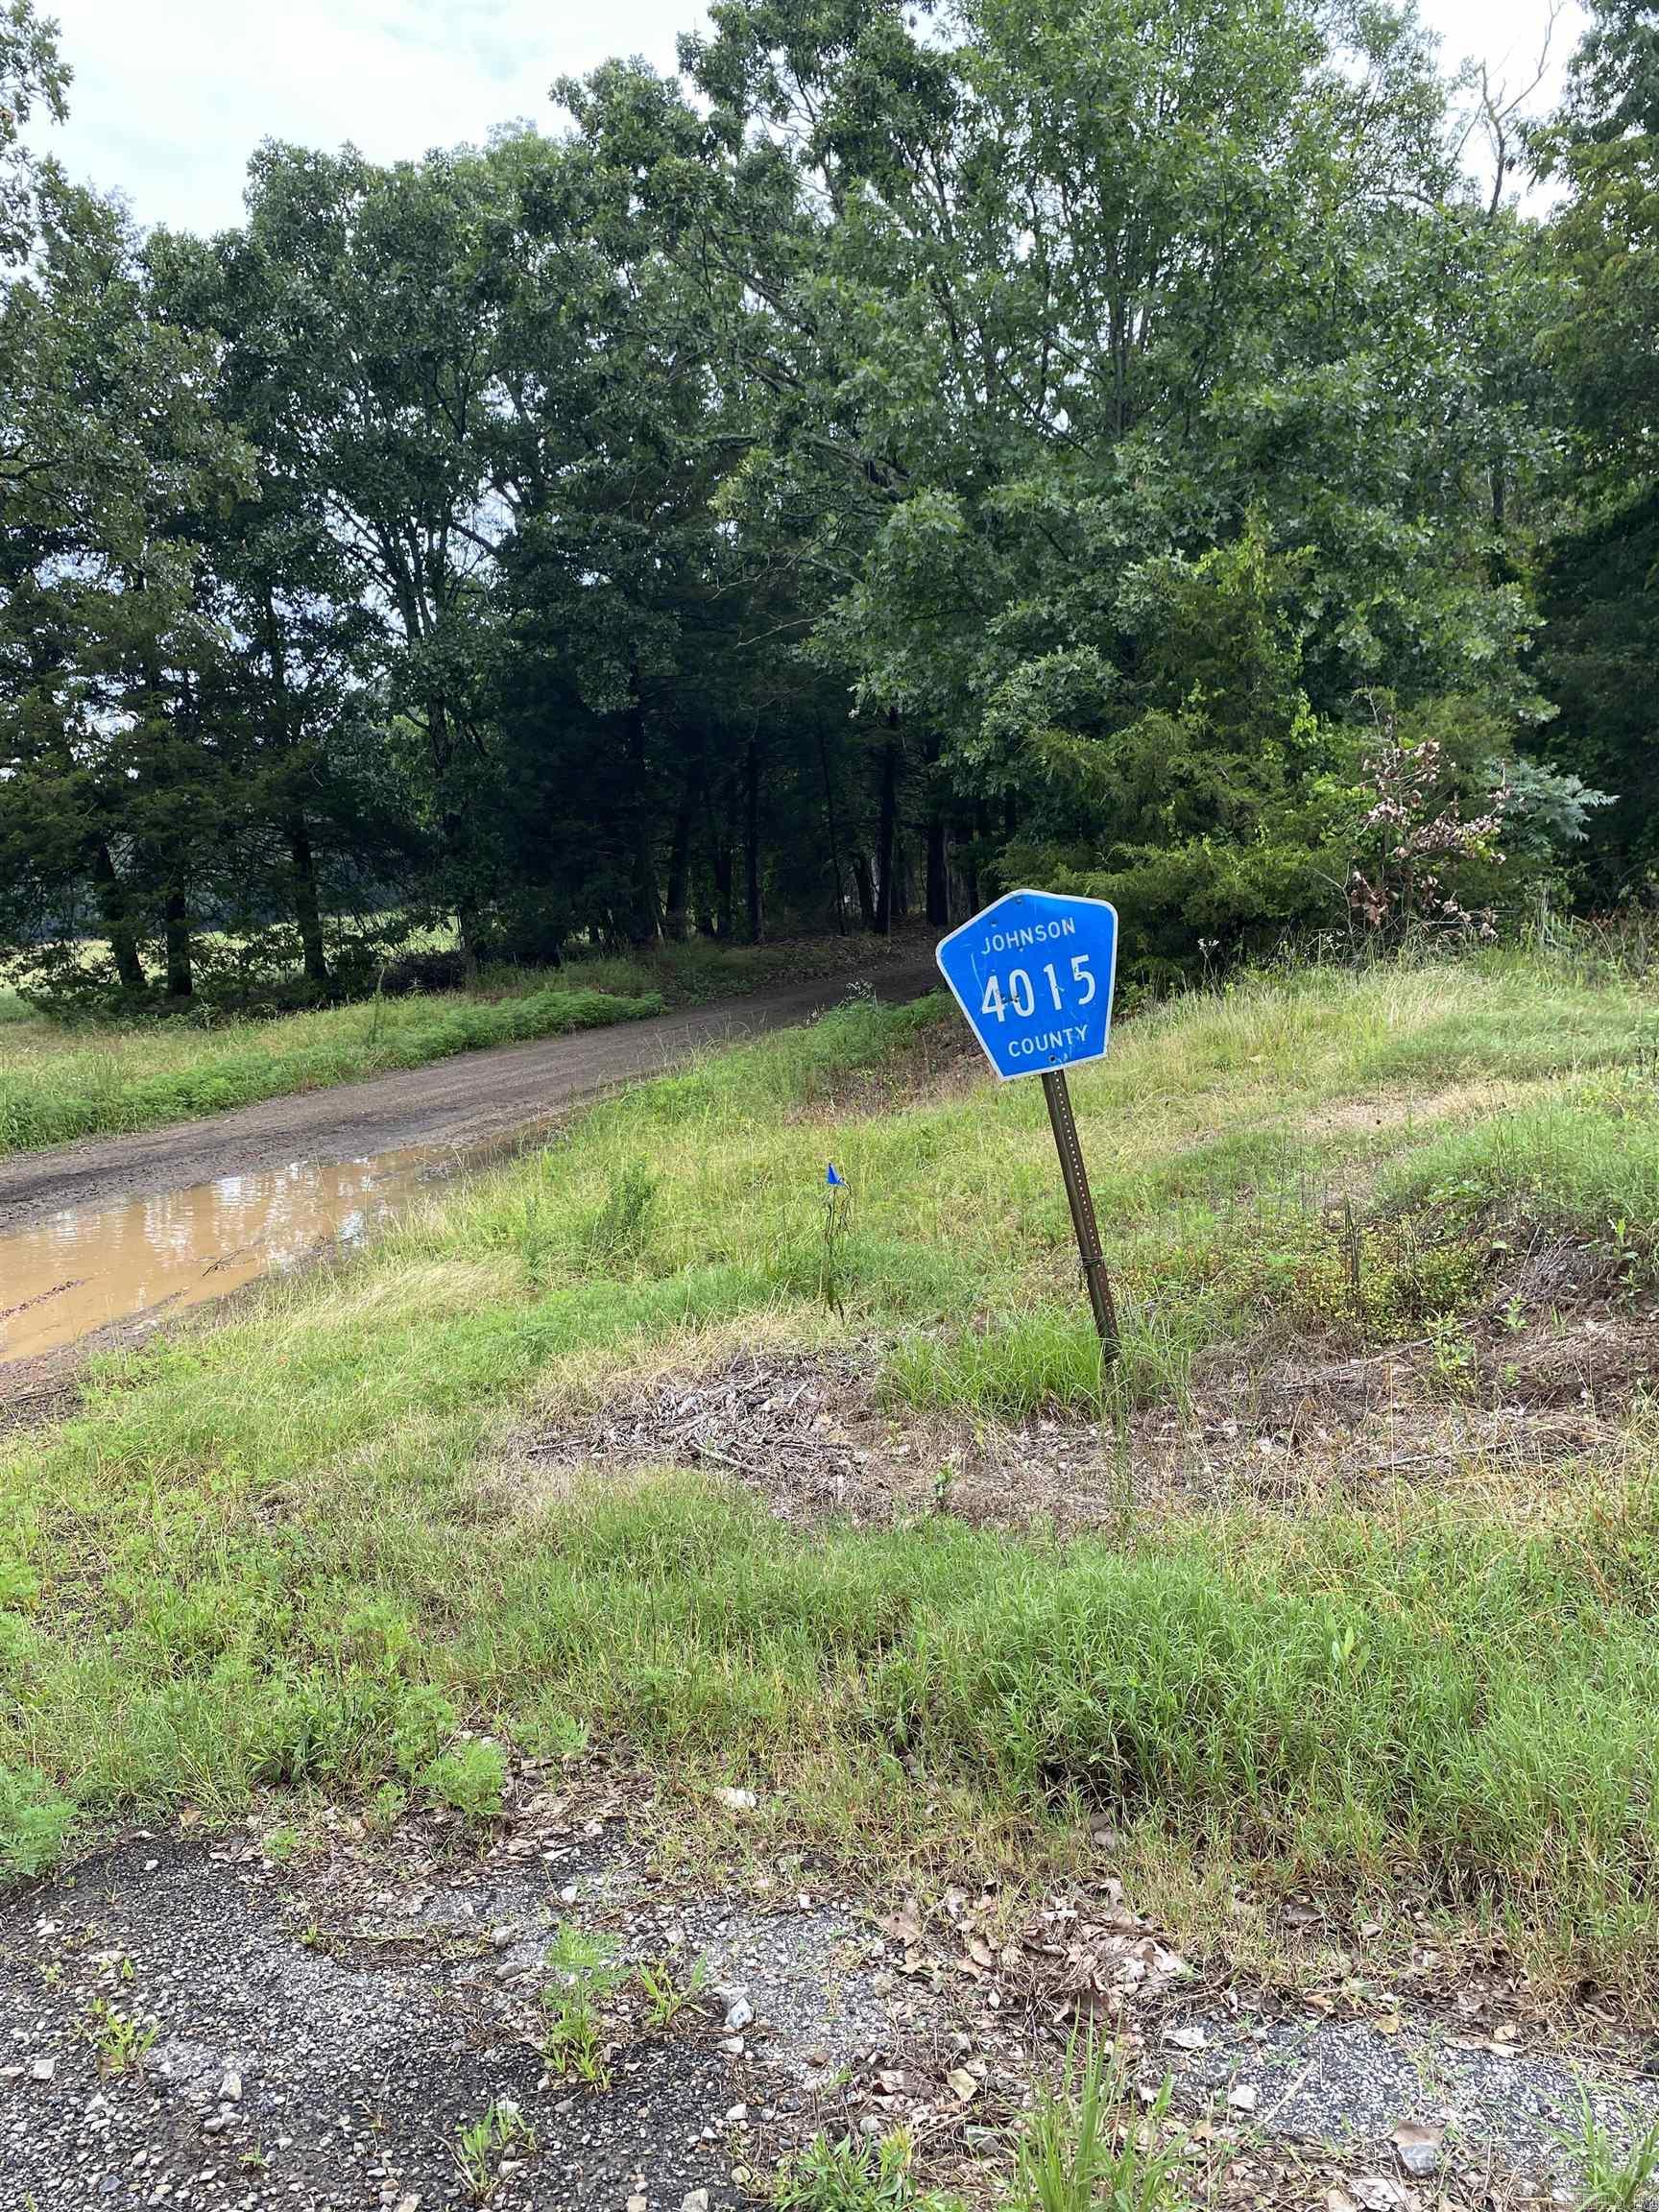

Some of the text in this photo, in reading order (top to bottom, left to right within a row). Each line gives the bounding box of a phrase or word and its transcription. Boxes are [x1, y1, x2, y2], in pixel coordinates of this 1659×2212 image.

[981, 917, 1076, 955] JOHNSON
[981, 954, 1096, 1022] 4015
[1008, 1024, 1089, 1057] COUNTY
